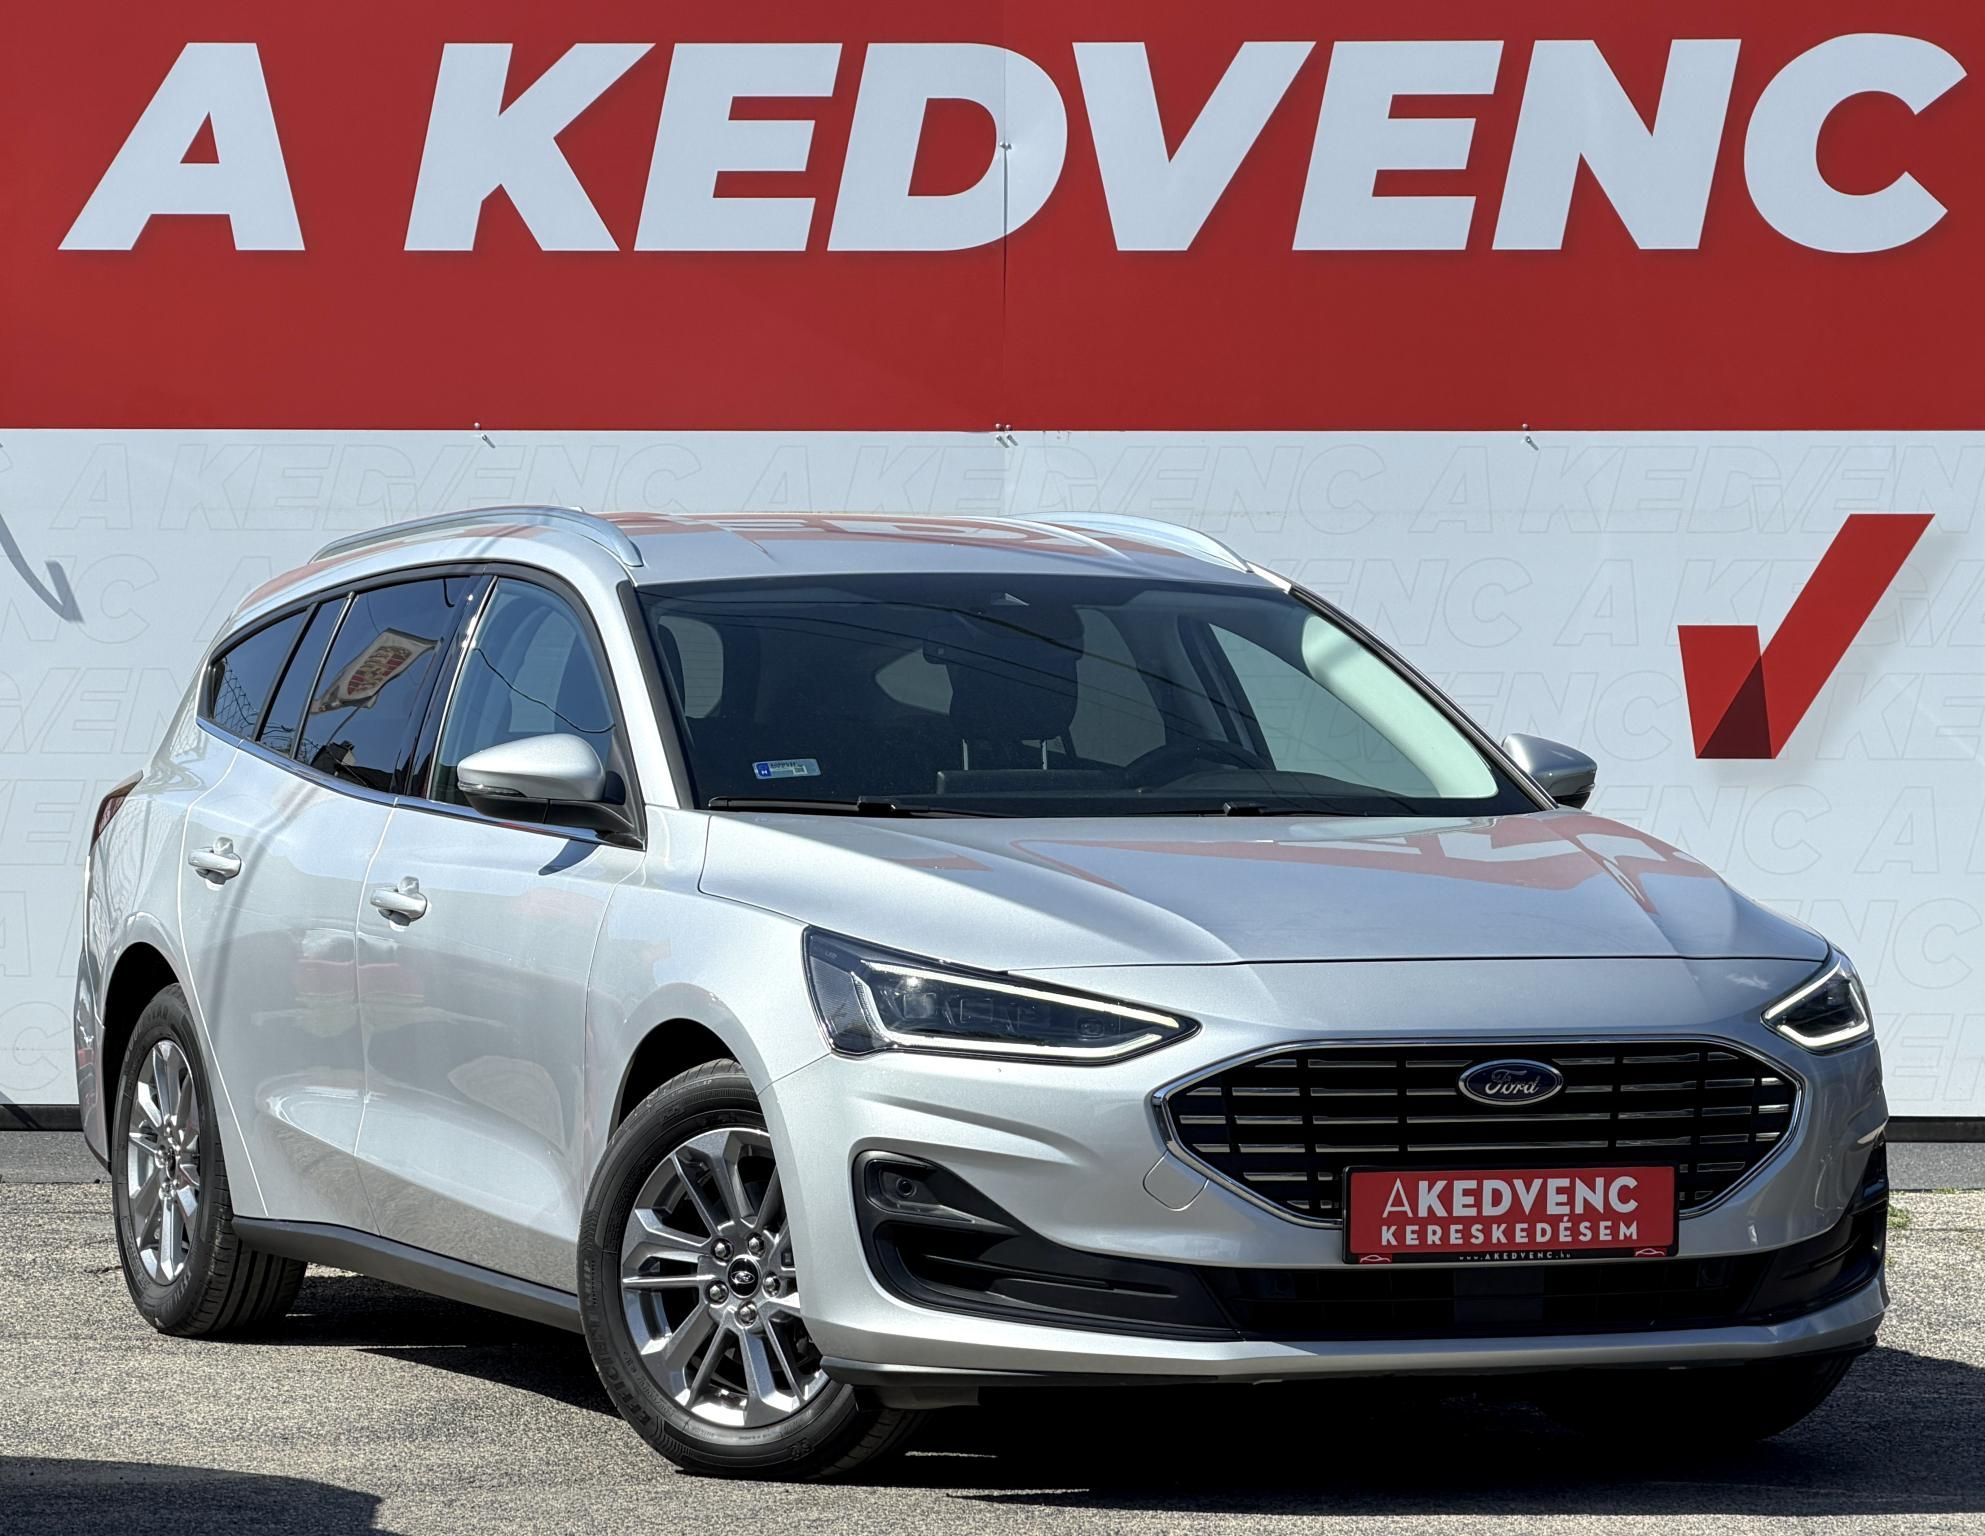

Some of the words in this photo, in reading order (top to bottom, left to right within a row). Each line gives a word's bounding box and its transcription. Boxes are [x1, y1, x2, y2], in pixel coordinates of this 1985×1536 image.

[59, 42, 306, 252] A
[404, 33, 1968, 254] KEDVENC
[1518, 445, 1985, 534] KEDVEN
[1484, 1068, 1541, 1095] Ford
[1382, 1176, 1639, 1218] AKEDVENC
[1381, 1216, 1638, 1246] KERESKEDÉSEM
[1459, 1251, 1571, 1261] www.AKEDVENC.hu
